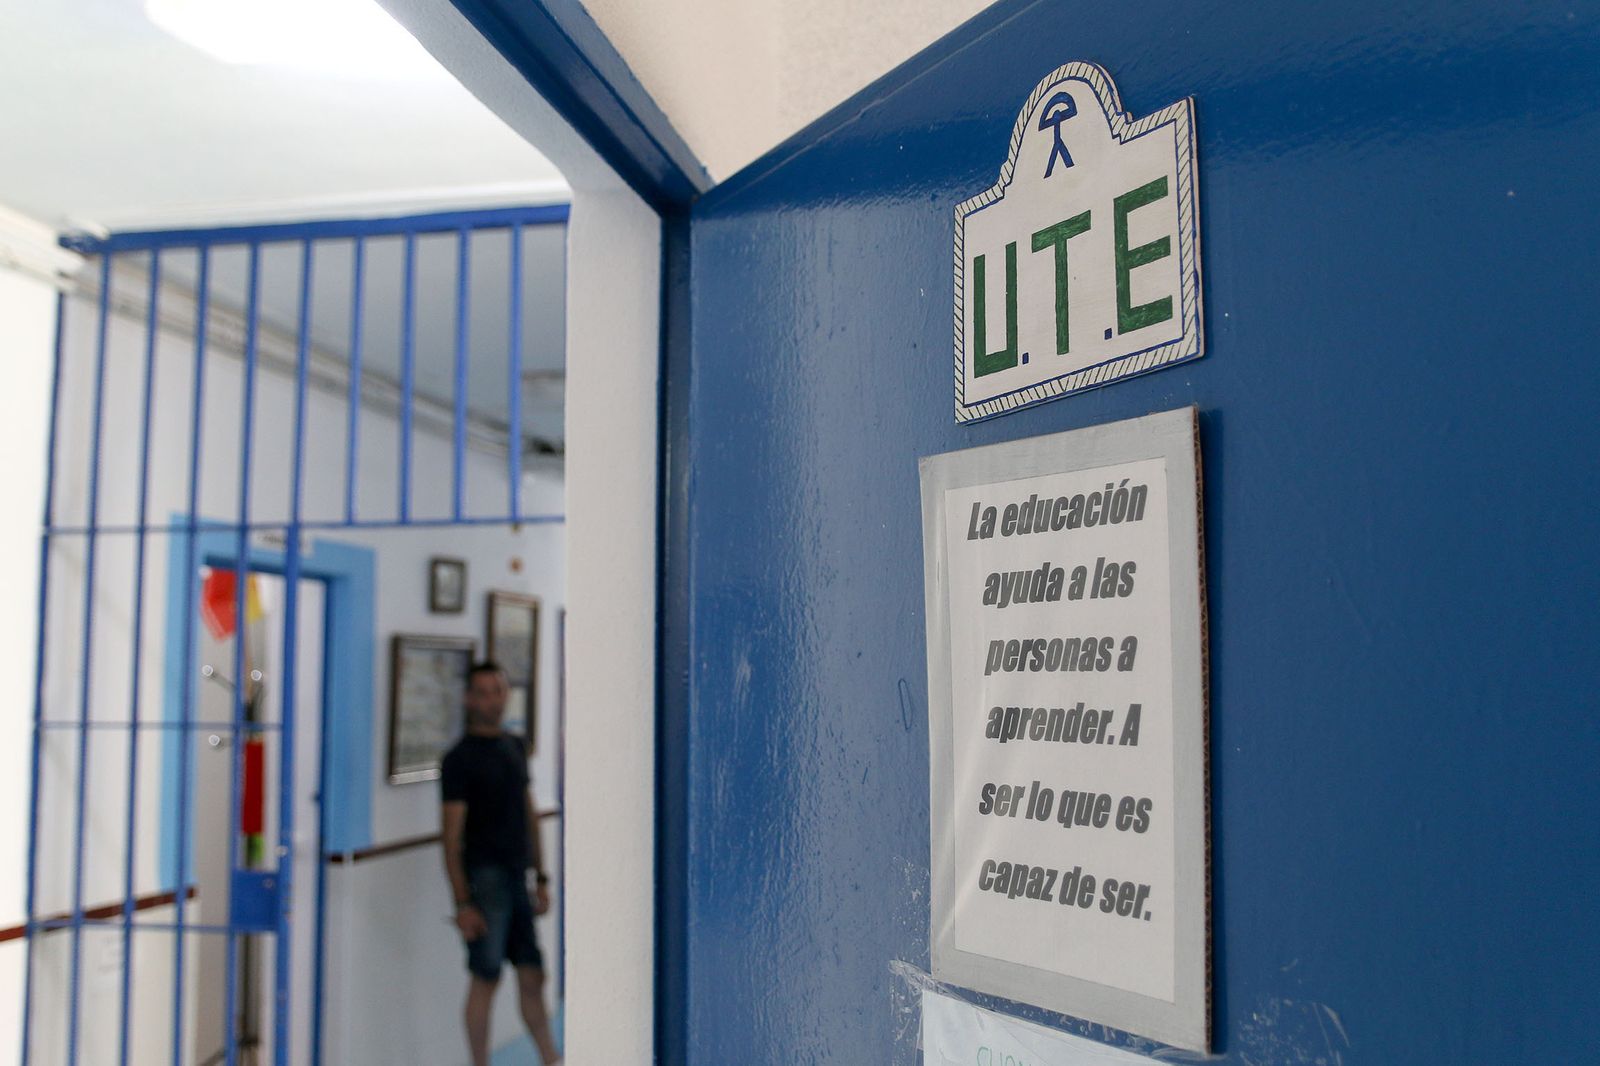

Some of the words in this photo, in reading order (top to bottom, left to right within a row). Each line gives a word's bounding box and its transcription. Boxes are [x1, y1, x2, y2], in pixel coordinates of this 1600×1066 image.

[973, 175, 1173, 379] U.T.E
[967, 501, 998, 541] La
[1000, 478, 1148, 537] educación
[982, 561, 1065, 609] ayuda
[1067, 565, 1088, 601] a
[1089, 556, 1137, 600] las
[984, 636, 1115, 676] personas
[1117, 635, 1138, 672] a
[985, 702, 1115, 745] aprender.
[1118, 703, 1142, 747] A
[978, 782, 1027, 818] ser
[1025, 780, 1055, 822] lo
[1056, 789, 1112, 829] que
[1115, 795, 1153, 834] es
[978, 859, 1059, 902] capaz
[1058, 866, 1097, 909] de
[1099, 878, 1152, 922] ser.
